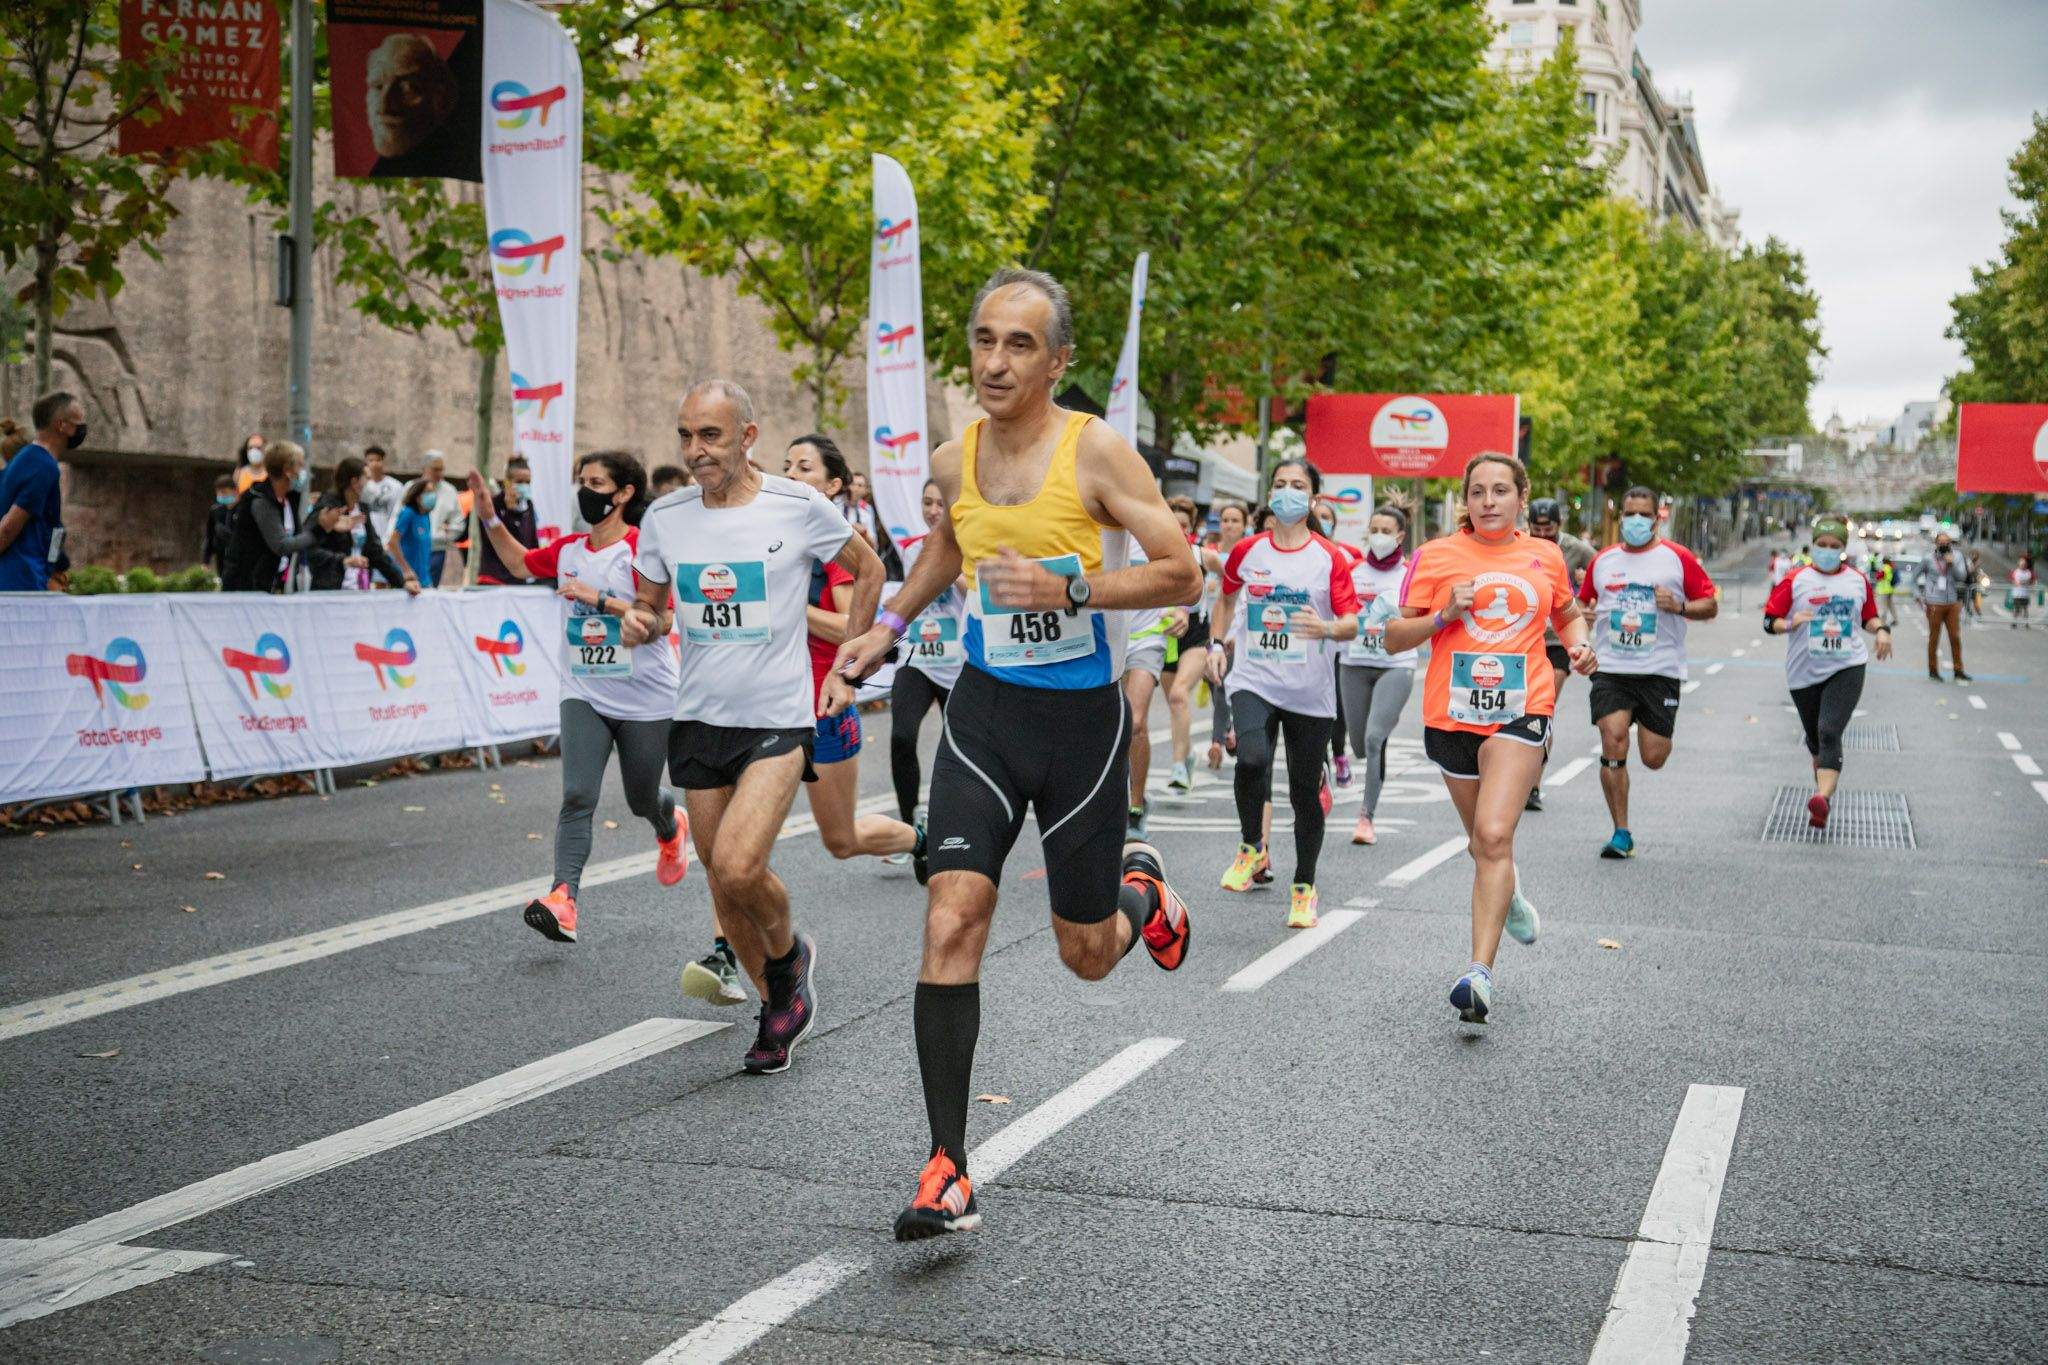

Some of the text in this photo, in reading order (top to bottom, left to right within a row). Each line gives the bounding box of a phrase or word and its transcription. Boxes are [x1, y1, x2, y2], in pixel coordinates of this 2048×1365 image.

[178, 52, 240, 66] ENTRO
[180, 67, 250, 83] LTURAL
[207, 86, 263, 98] VILLA
[702, 603, 743, 628] 431
[1011, 611, 1062, 643] 458
[1260, 632, 1289, 651] 440
[1619, 632, 1642, 647] 426
[580, 645, 616, 665] 1222
[919, 641, 945, 657] 449
[1469, 689, 1506, 710] 454
